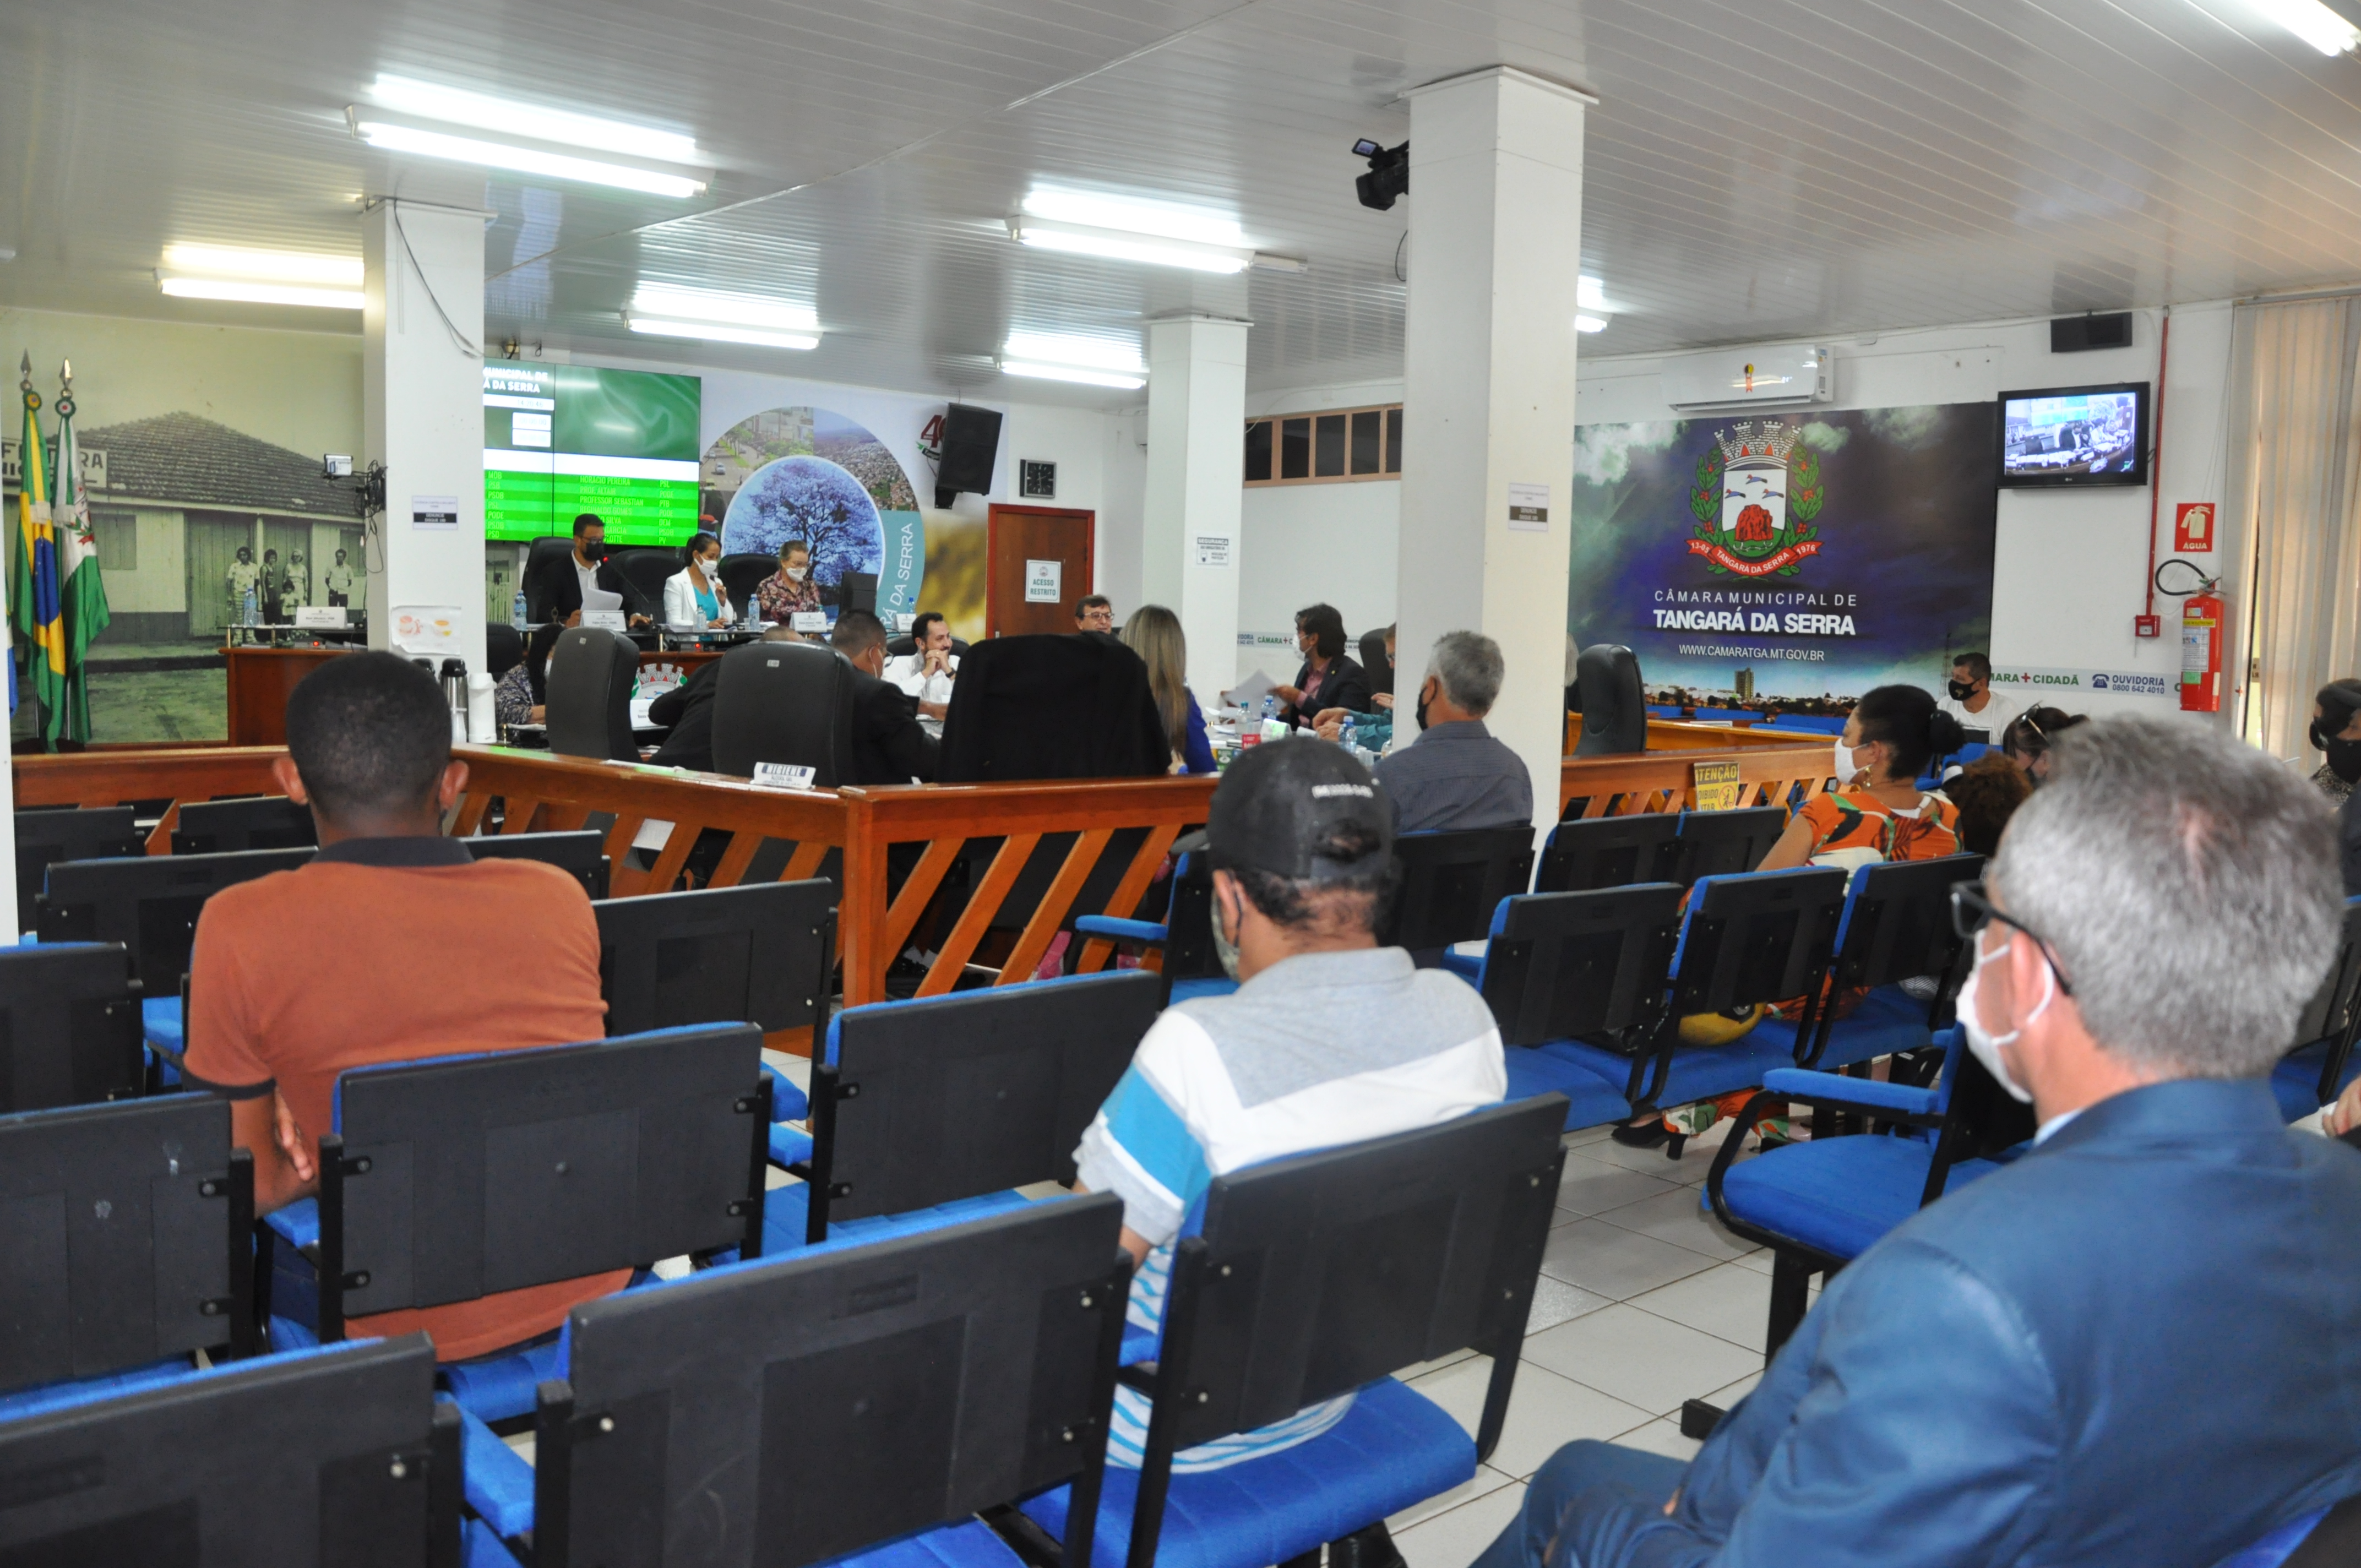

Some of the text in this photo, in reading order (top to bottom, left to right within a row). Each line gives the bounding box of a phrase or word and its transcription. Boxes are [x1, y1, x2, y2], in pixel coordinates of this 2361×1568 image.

[535, 371, 548, 382] DE
[492, 380, 506, 390] DA
[508, 381, 540, 393] SERRA
[607, 477, 630, 486] PEREIRA
[597, 487, 616, 495] ALTAIR
[580, 496, 612, 504] PROFESSOR
[614, 498, 644, 507] SEBASTIAN
[487, 511, 504, 519] PODE
[612, 507, 632, 515] GOMES
[606, 516, 622, 524] SILVA
[605, 526, 627, 534] GARCIA
[897, 522, 914, 581] SERRA
[1690, 542, 1710, 553] 13-05
[1717, 549, 1749, 573] TANGARÁ
[1762, 552, 1789, 571] SERRA
[1796, 544, 1816, 555] 1976
[890, 584, 907, 606] DA
[1655, 589, 1857, 606] CÂMARA MUNICIPAL DE
[1653, 606, 1856, 635] TANGARÁ DA SERRA
[1679, 644, 1825, 661] WWW.CAMARATGA.MT.GOV.BR
[2033, 674, 2079, 685] CIDADÃ
[2112, 675, 2165, 687] OUVIDORIA
[2146, 686, 2165, 694] 4010
